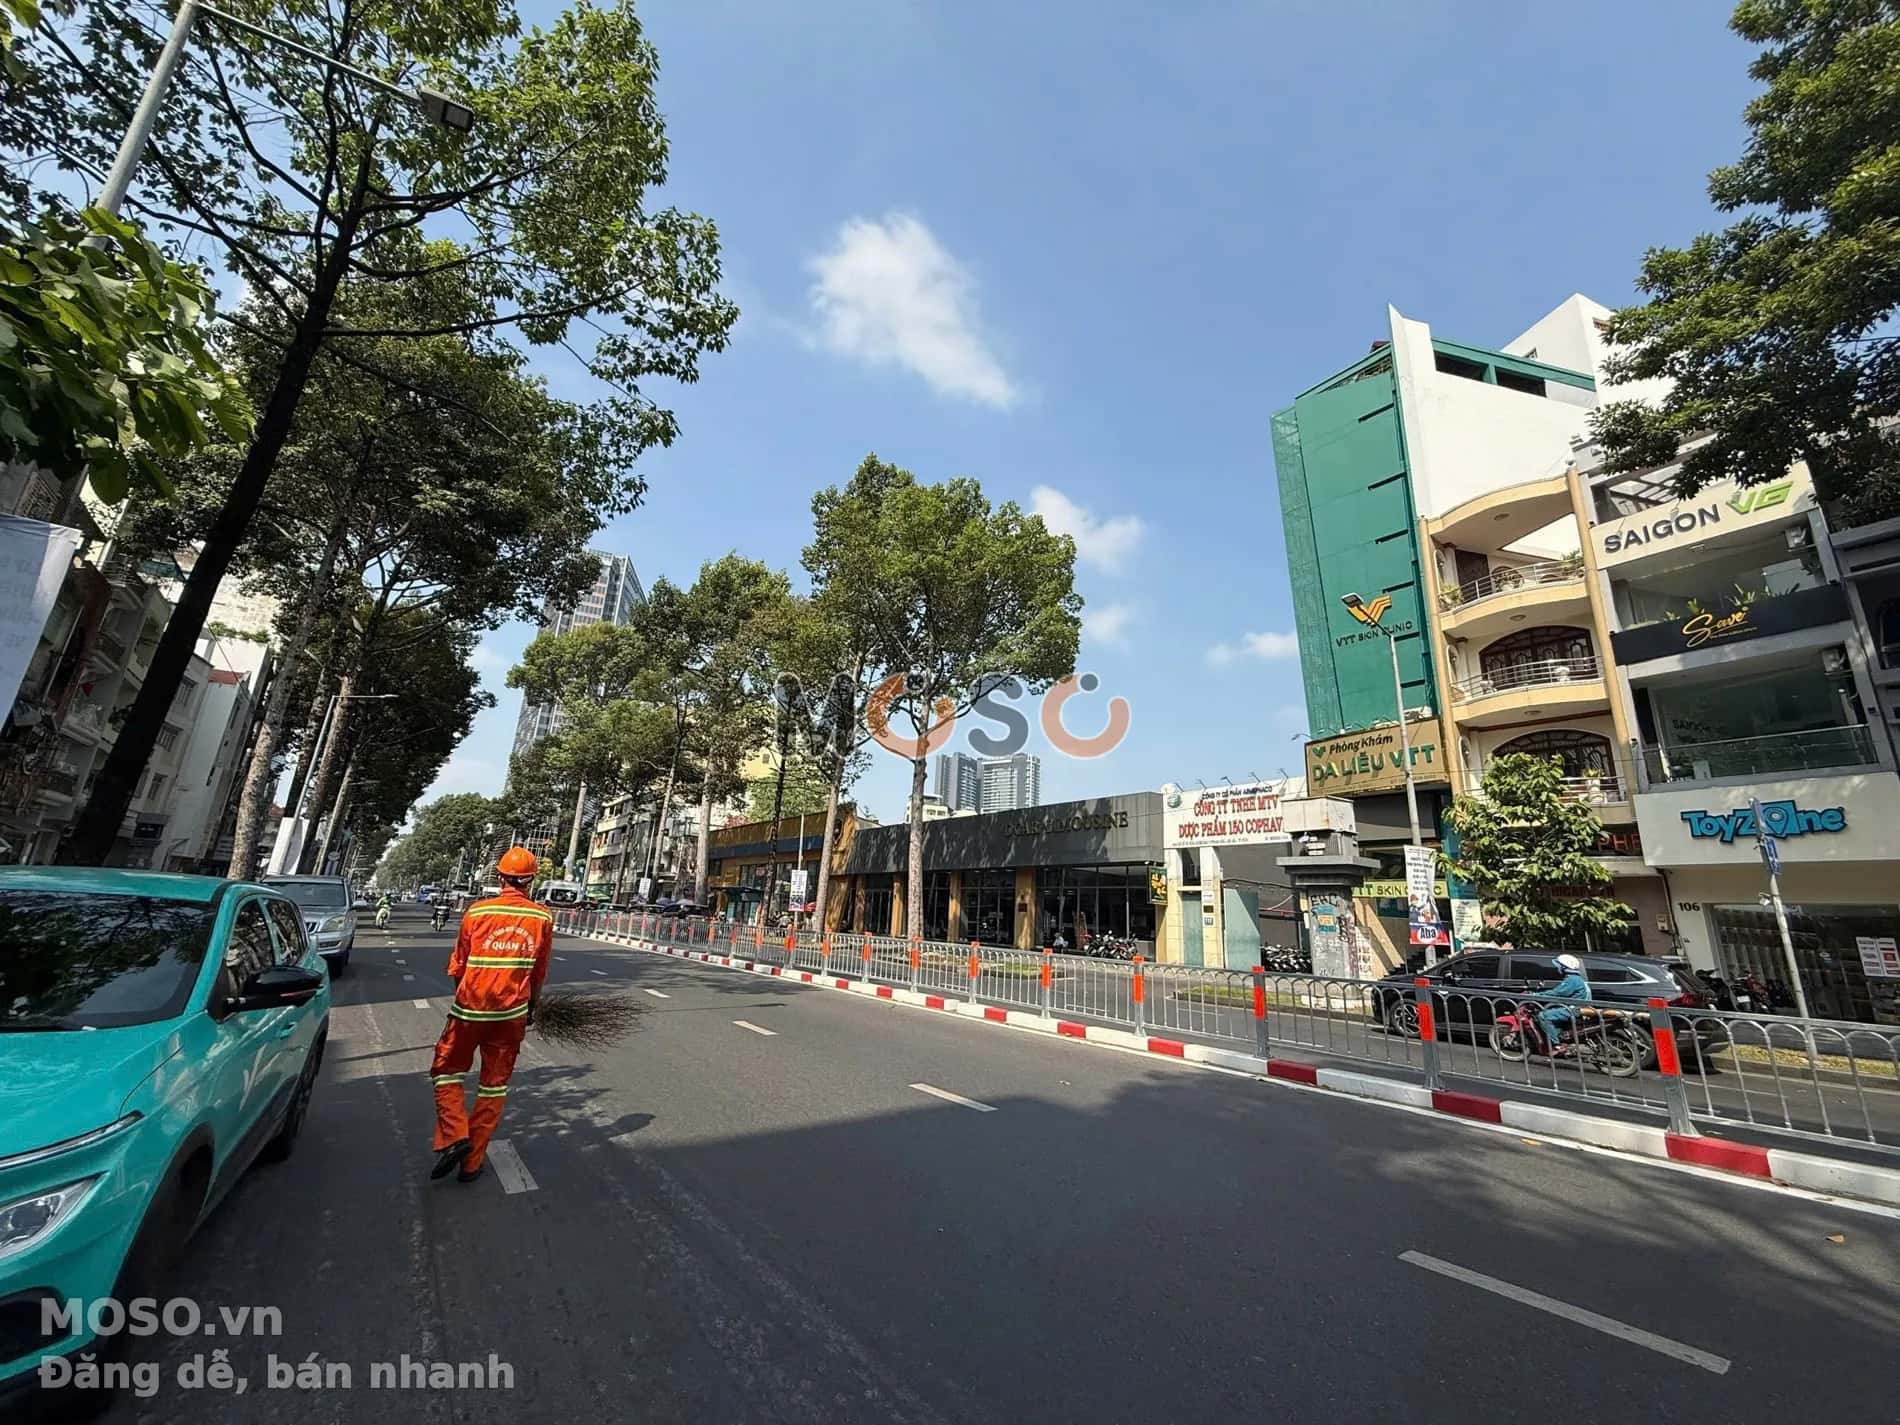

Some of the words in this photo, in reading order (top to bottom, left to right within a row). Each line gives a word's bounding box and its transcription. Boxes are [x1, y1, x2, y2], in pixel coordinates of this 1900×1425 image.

[1604, 504, 1721, 553] SAIGON
[1335, 634, 1356, 647] VTT
[1361, 734, 1393, 748] Khám
[1312, 762, 1339, 781] DA
[1389, 744, 1435, 768] VTT
[1194, 798, 1215, 816] CÔNG
[1216, 799, 1228, 815] TY
[1257, 794, 1280, 811] MTV
[1229, 820, 1244, 835] 150
[1376, 885, 1402, 896] SKIN
[1679, 902, 1700, 912] 106
[1420, 927, 1436, 939] Aba
